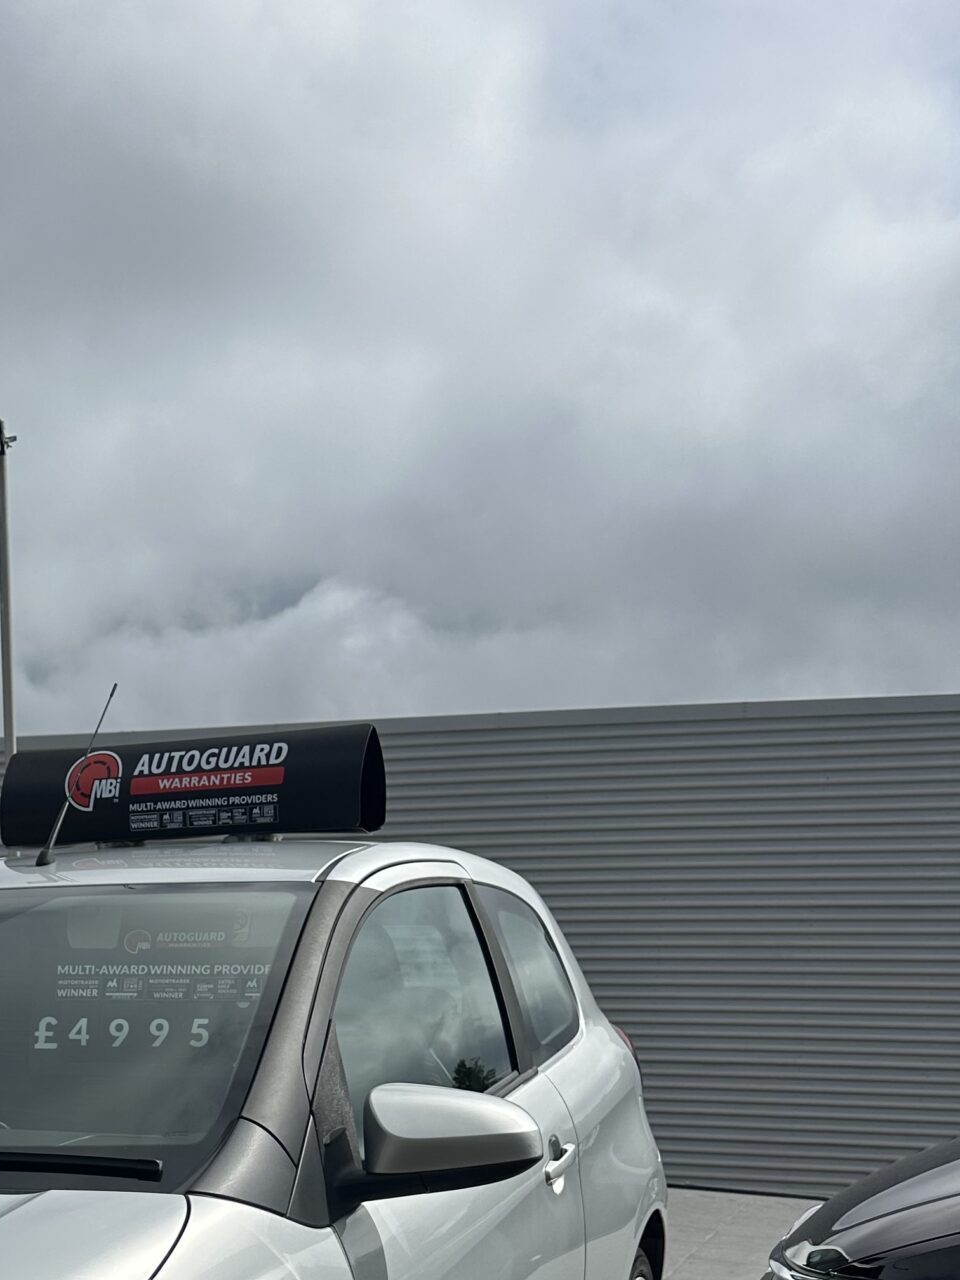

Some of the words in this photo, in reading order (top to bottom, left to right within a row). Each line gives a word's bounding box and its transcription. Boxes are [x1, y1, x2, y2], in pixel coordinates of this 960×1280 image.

[133, 743, 289, 776] AUTOGUARD
[158, 772, 252, 790] WARRANTIES
[129, 800, 187, 812] MULTI-AWARD
[188, 797, 227, 808] WINNING
[229, 794, 278, 804] PROVIDERS
[131, 821, 158, 829] WINNER
[156, 931, 226, 942] AUTOGUARD
[57, 964, 148, 976] MULTI-AWARD
[149, 964, 210, 976] WINNING
[57, 988, 98, 997] WINNER
